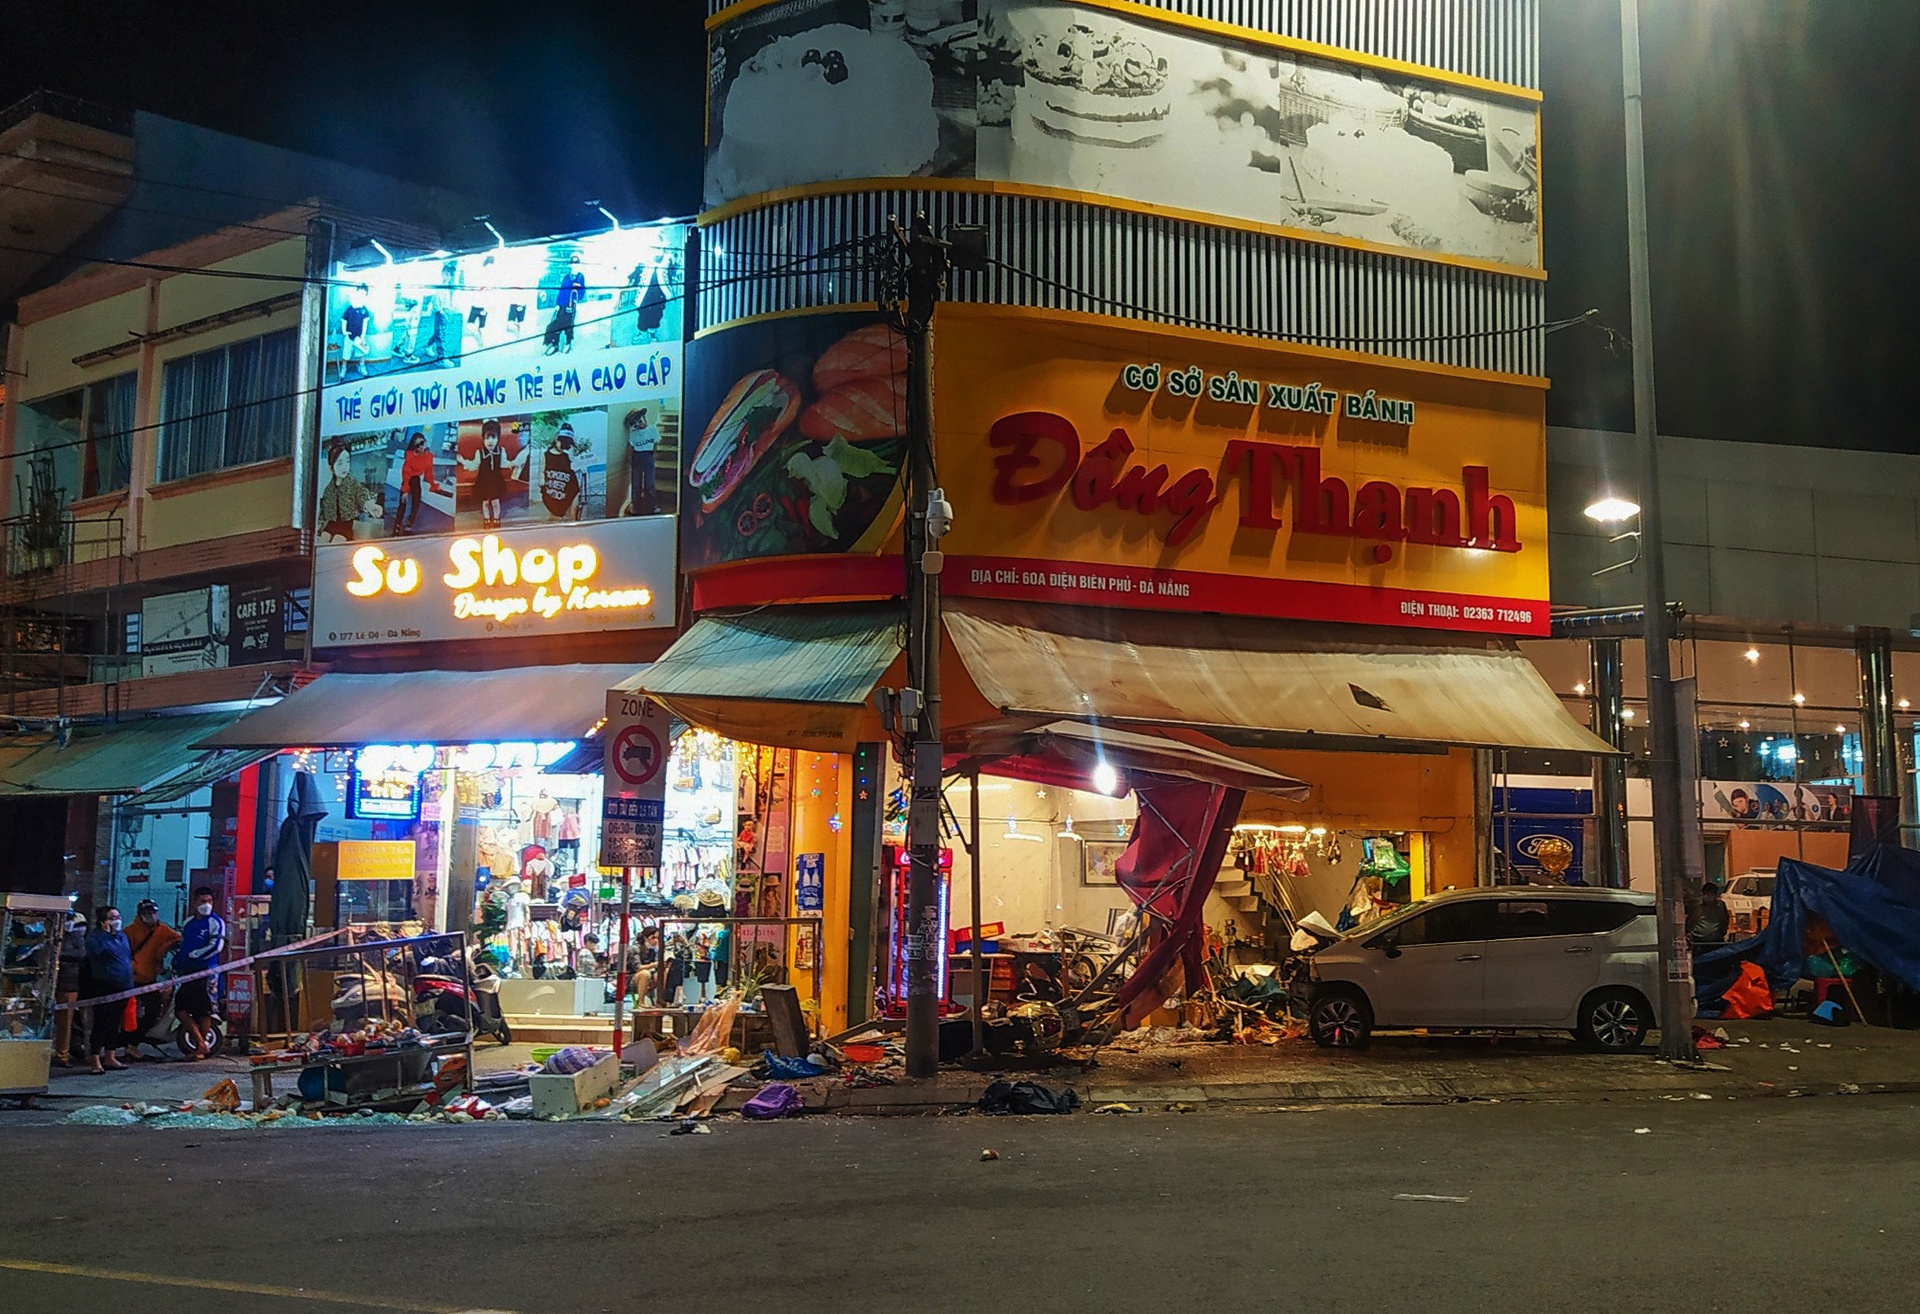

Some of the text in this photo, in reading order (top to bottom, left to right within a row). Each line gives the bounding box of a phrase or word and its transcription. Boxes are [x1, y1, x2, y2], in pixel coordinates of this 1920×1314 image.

[336, 351, 672, 422] THẾ GIỚI THỜI TRANG TRẺ EM CAO CẤP
[1124, 362, 1415, 424] CƠ SỞ SẢN XUẤT BÁNH
[1226, 439, 1523, 563] Thạnh
[347, 534, 599, 597] Su Shop
[971, 569, 992, 585] ĐỊA
[1022, 571, 1046, 586] 60A
[1049, 571, 1076, 591] ĐIỆN
[1079, 573, 1106, 590] BIÊN
[1108, 575, 1131, 592] PHỦ
[260, 599, 276, 615] 175
[532, 585, 563, 619] by
[1400, 600, 1532, 623] ĐIỆN THOẠI: 02363 712496
[340, 632, 353, 640] 177
[621, 698, 654, 718] ZONE
